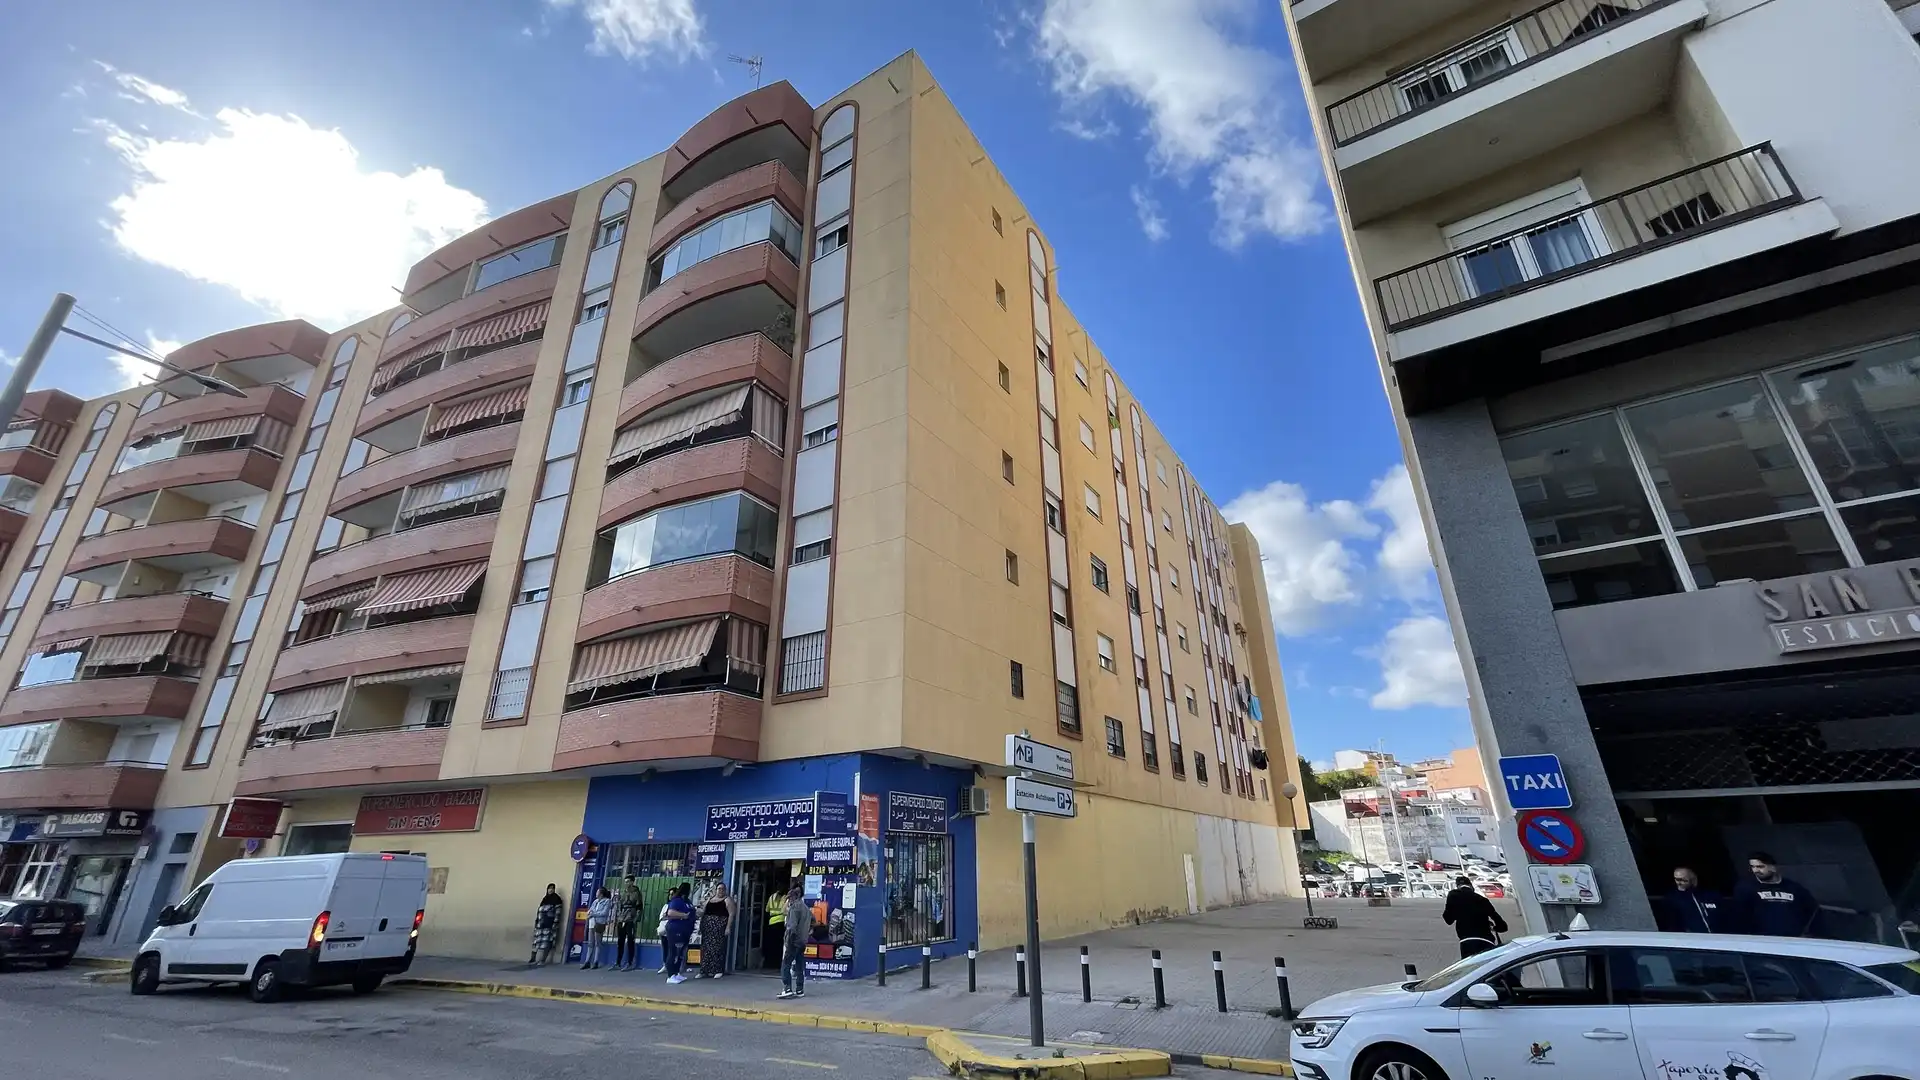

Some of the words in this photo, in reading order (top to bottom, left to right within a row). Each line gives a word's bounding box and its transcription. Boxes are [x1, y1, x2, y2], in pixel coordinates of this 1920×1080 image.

[1756, 574, 1870, 621] SAN
[1506, 772, 1563, 791] TAXI
[360, 793, 440, 811] SUPERMERCADO
[445, 790, 480, 807] BAZAR
[891, 794, 925, 809] SUPERMERCADO
[926, 798, 945, 810] ZOMOROD
[711, 804, 771, 819] SUPERMERCADO
[773, 801, 813, 815] ZOMOROD
[820, 807, 845, 815] ZOMOROD
[61, 812, 105, 825] TABACOS
[744, 817, 779, 830] ممتاز
[786, 816, 809, 828] سوق
[712, 819, 737, 831] زمرد
[728, 831, 748, 840] BAZAR
[809, 838, 831, 848] TRANSPORTE
[832, 837, 837, 848] DE
[837, 836, 855, 847] EQUIPAJE
[828, 849, 851, 861] MARRUECOS
[809, 866, 826, 875] BAZAR
